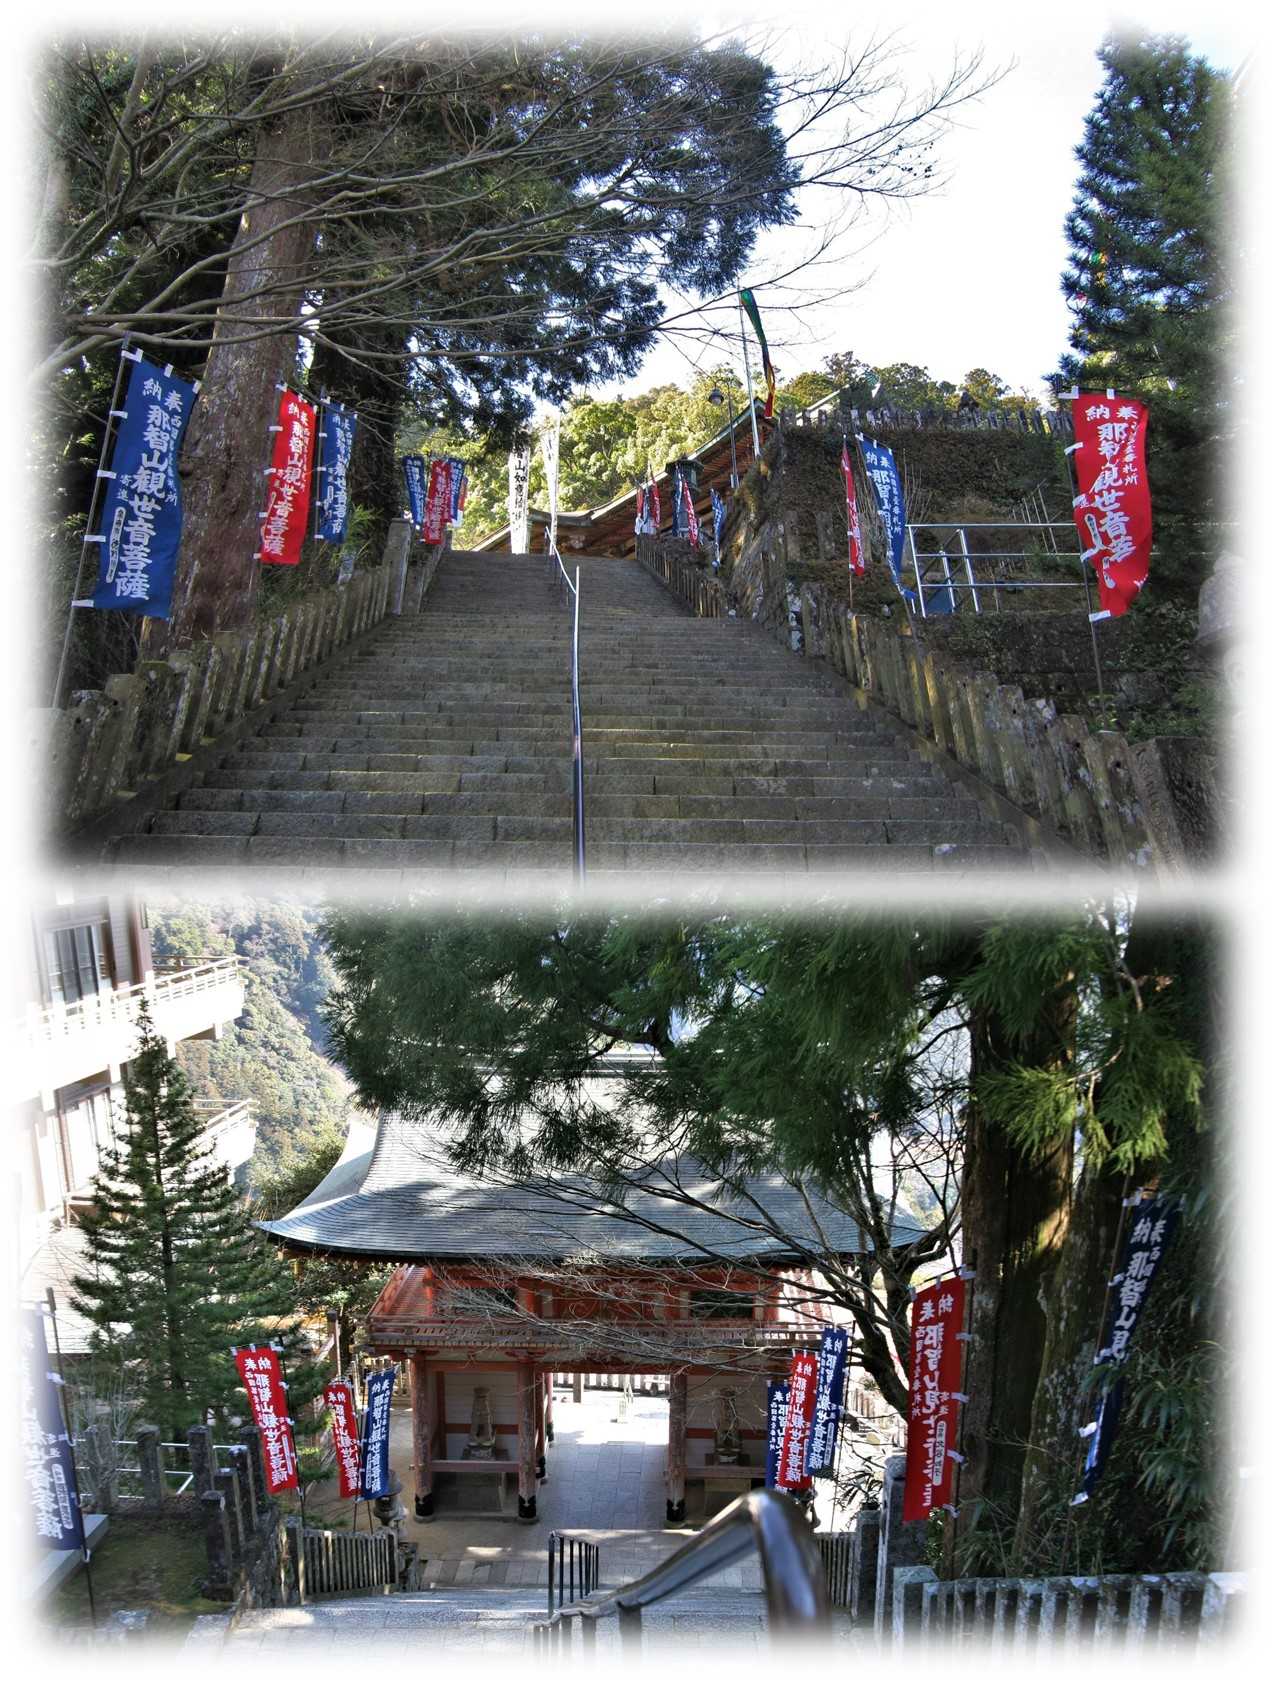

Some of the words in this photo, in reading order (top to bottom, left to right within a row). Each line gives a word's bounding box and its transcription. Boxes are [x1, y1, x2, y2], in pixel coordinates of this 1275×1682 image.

[142, 378, 182, 413] 奉納
[1085, 405, 1139, 422] 奉納
[115, 404, 170, 600] 那智山観世音菩薩
